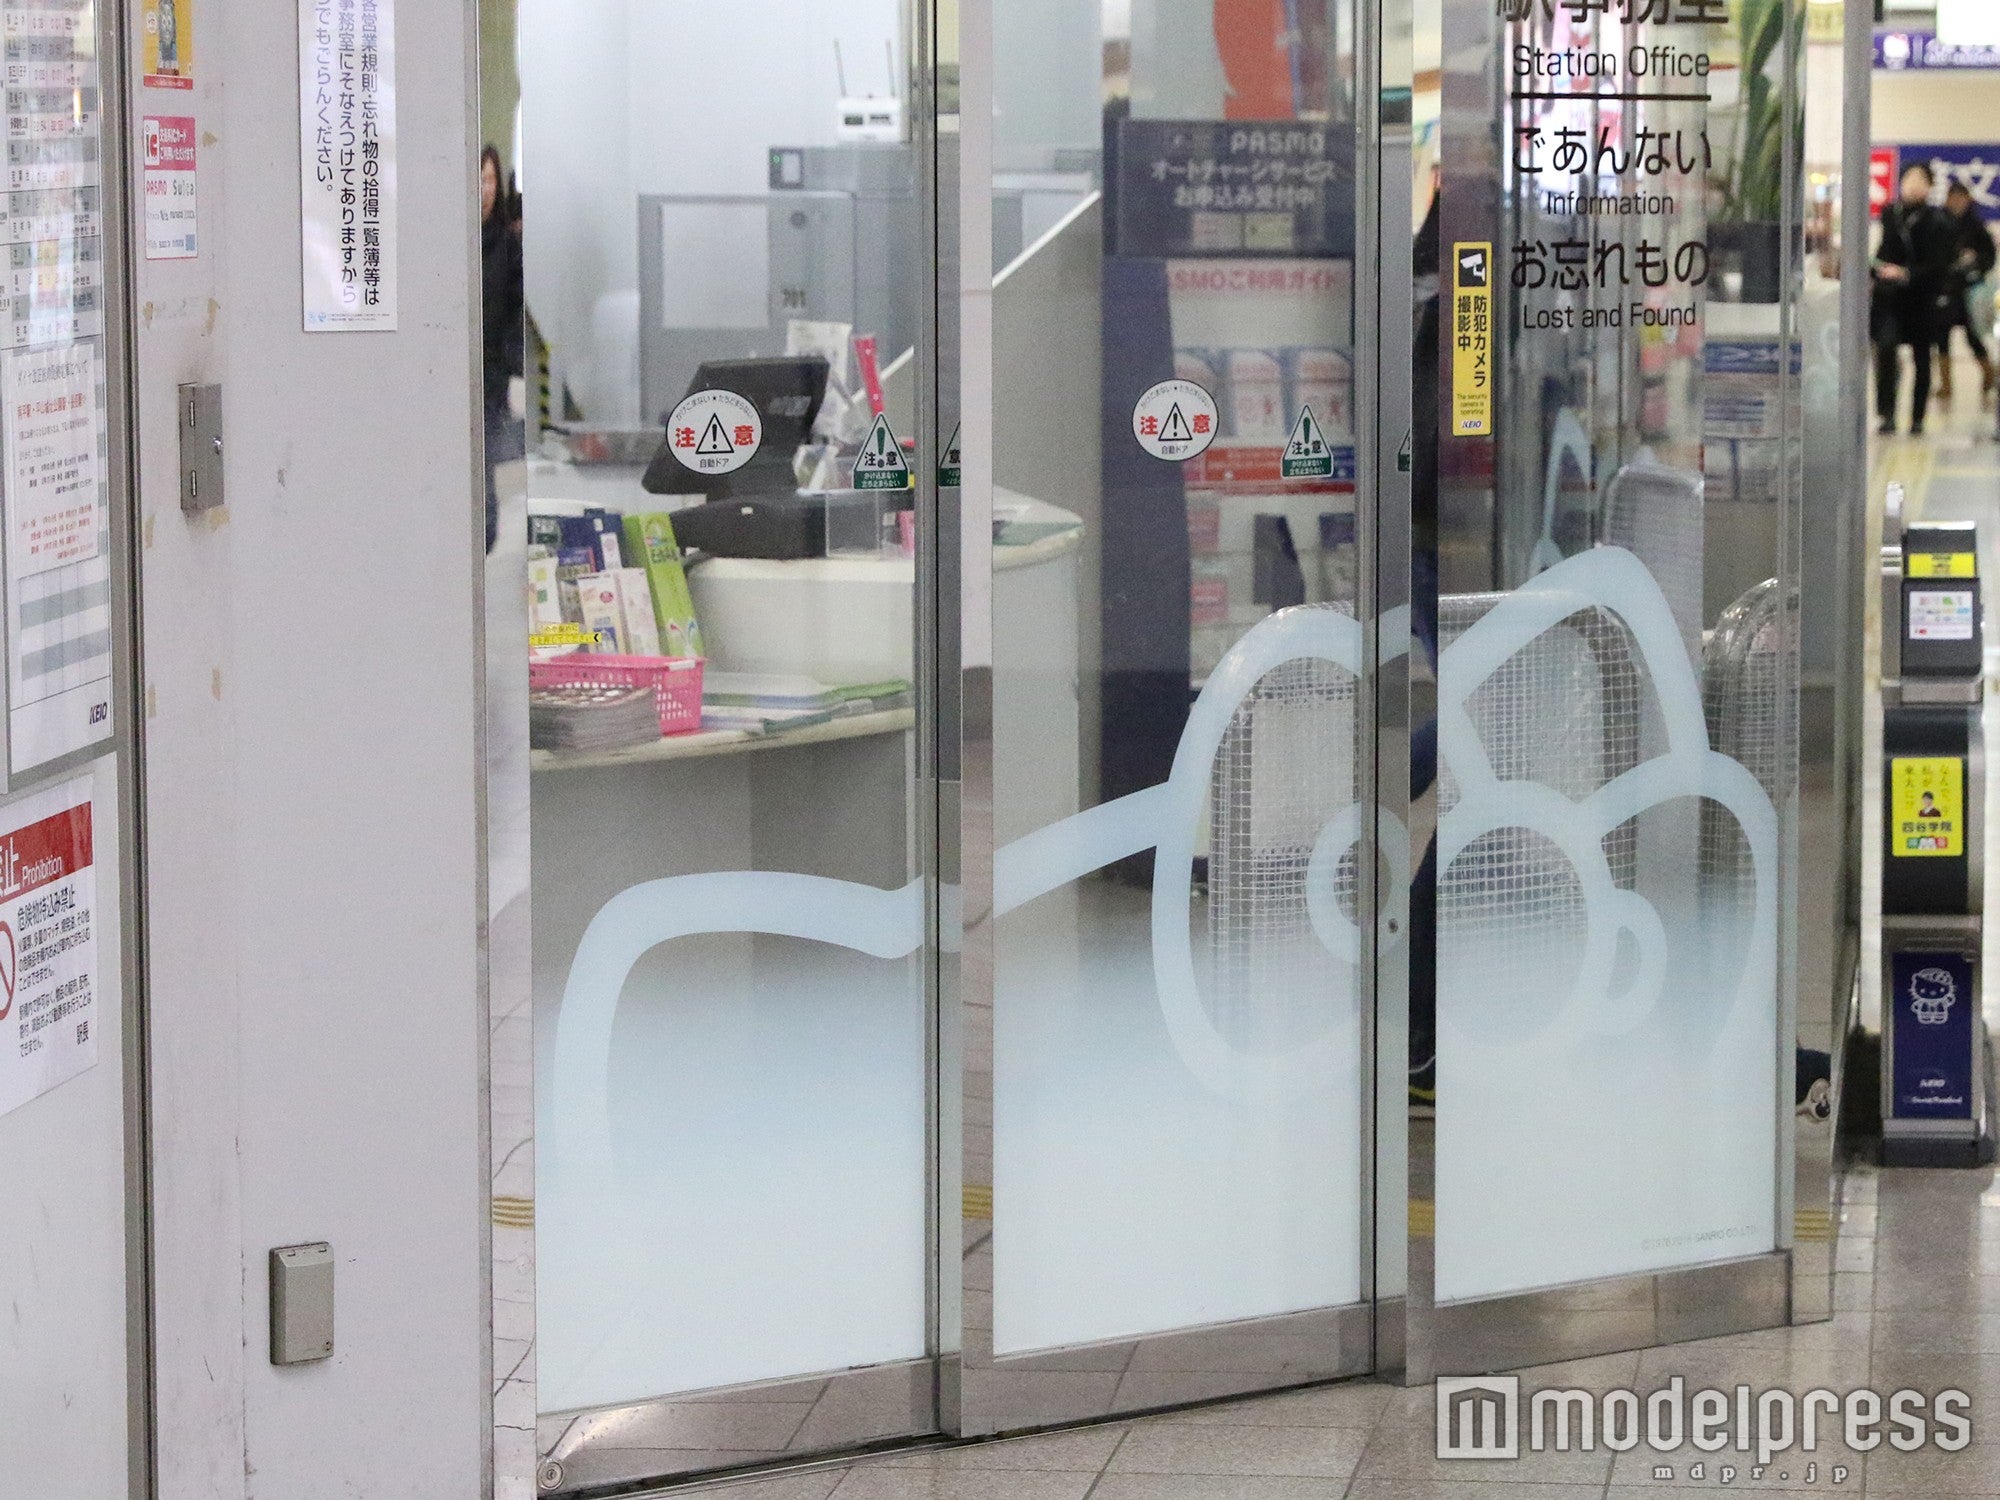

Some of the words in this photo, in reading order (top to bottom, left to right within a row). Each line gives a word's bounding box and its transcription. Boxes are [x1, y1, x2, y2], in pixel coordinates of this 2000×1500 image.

[1512, 45, 1616, 76] Station
[1628, 45, 1711, 77] Office
[315, 0, 334, 193] でもごらんください。
[1230, 129, 1326, 155] PASMO
[1513, 125, 1712, 176] ごあんない
[1546, 192, 1674, 215] Information
[1511, 239, 1711, 290] お忘れもの
[1457, 295, 1471, 352] 撮影中
[1523, 305, 1574, 329] Lost
[1582, 304, 1621, 328] and
[1630, 302, 1697, 326] Found
[1473, 295, 1487, 388] 防犯カメラ
[674, 426, 697, 448] 注
[733, 424, 755, 447] 意
[1140, 414, 1159, 436] 注
[1192, 413, 1211, 435] 意
[864, 451, 877, 467] 注
[886, 450, 898, 467] 意
[1161, 445, 1189, 455] 自動ドア
[1291, 440, 1303, 455] 注
[1311, 439, 1322, 454] 意
[699, 457, 730, 469] 自動ドア
[89, 701, 107, 725] KEIO
[22, 854, 63, 888] Prohibition
